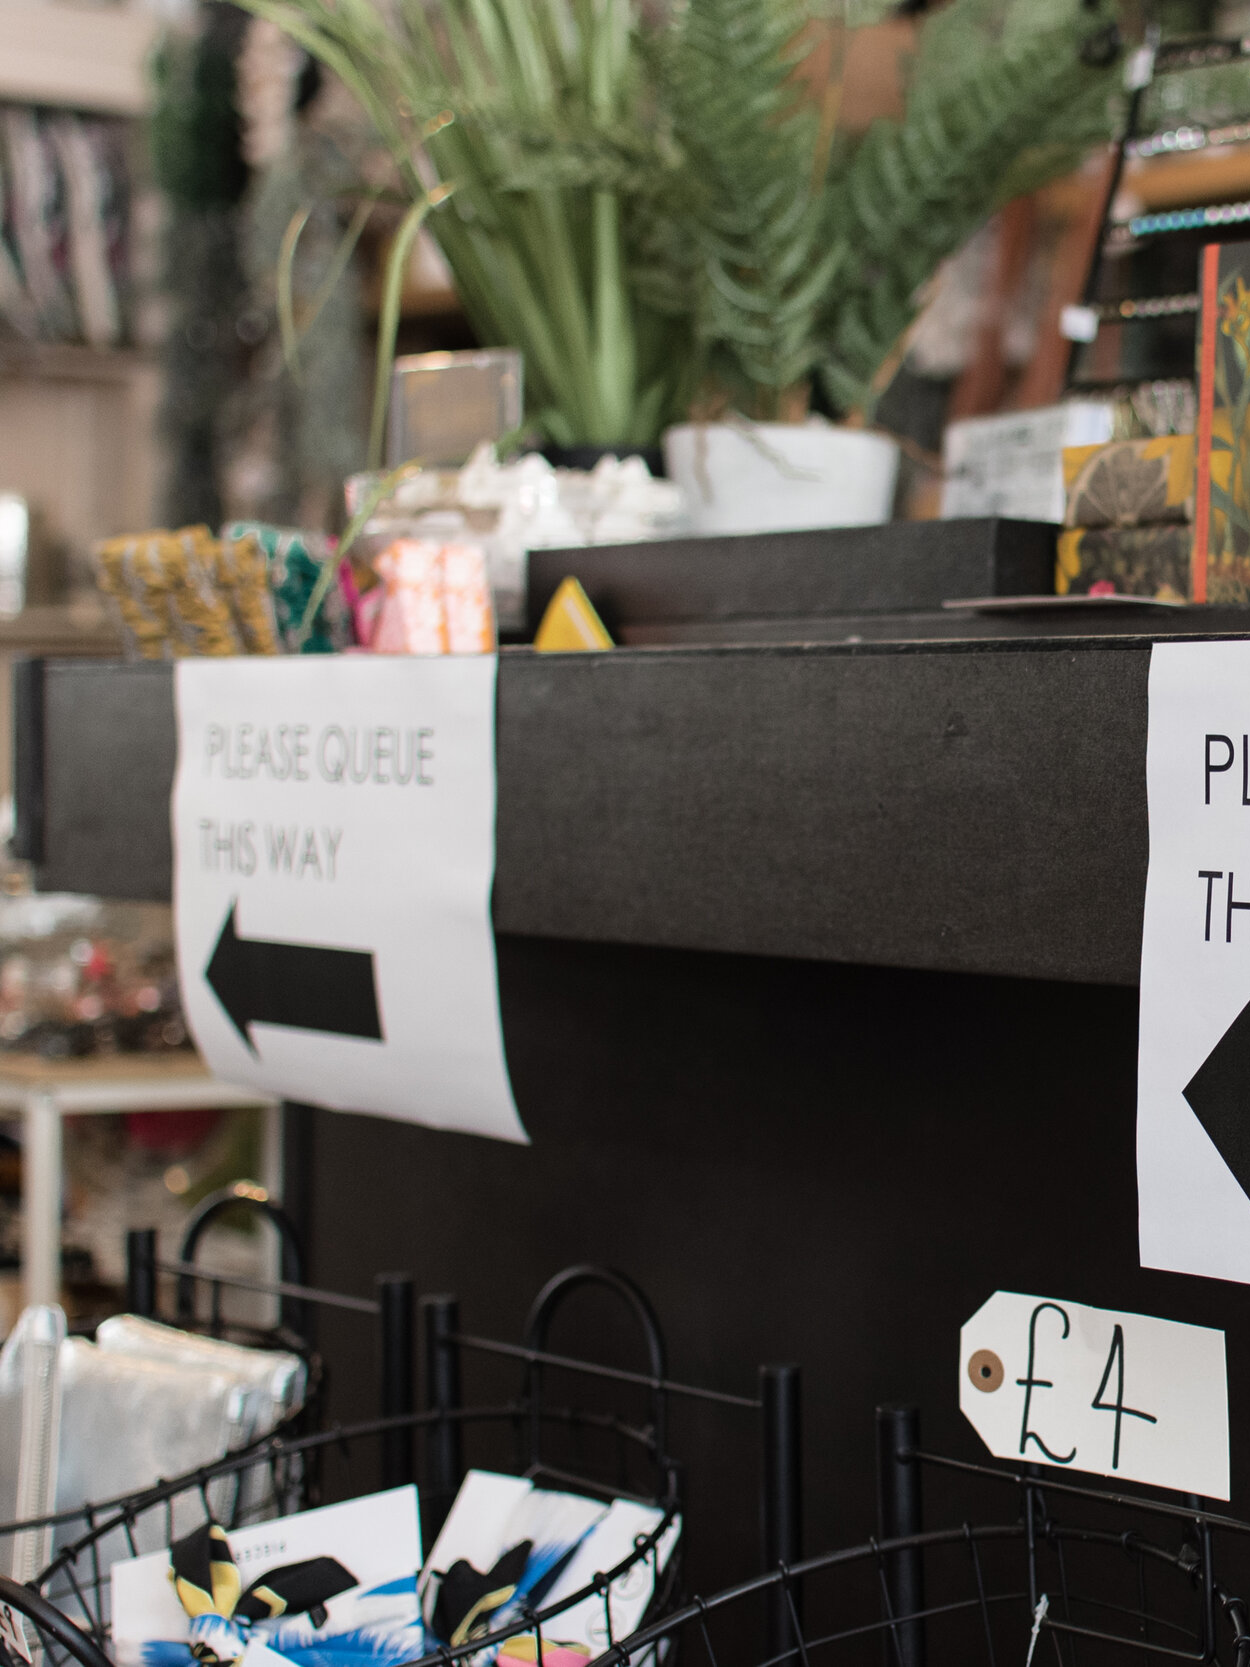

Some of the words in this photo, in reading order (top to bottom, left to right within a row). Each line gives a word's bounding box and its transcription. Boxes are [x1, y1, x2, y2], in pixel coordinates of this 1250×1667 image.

[206, 723, 310, 781] PLEASE
[316, 724, 434, 786] QUEUE
[199, 817, 257, 877] THIS
[264, 823, 343, 882] WAY
[1016, 1302, 1157, 1470] £4
